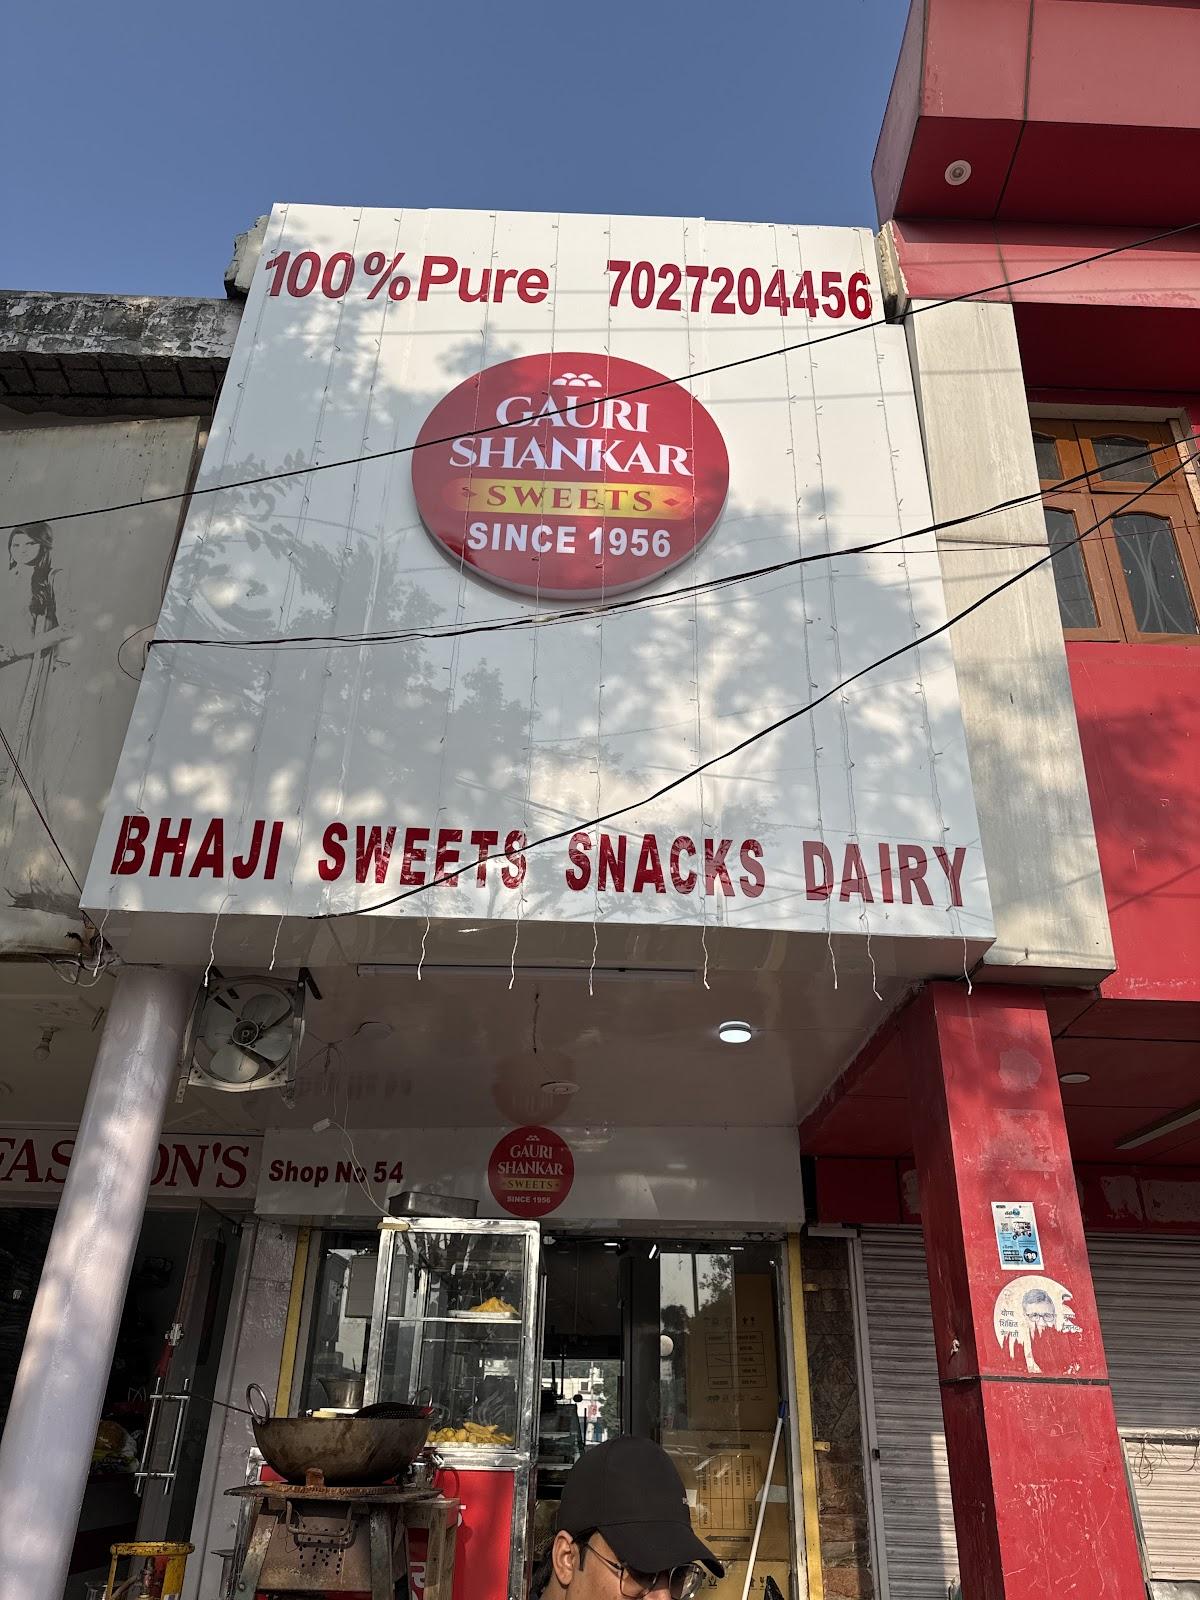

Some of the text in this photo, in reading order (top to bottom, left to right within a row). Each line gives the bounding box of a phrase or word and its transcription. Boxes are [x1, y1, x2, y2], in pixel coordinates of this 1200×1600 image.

[607, 260, 872, 320] 7027204456
[496, 396, 649, 433] GAURI
[449, 436, 694, 476] SHANKAR
[486, 485, 653, 512] SWEETS
[467, 522, 671, 558] SINCE 1956
[110, 815, 967, 907] BHAJI SWEETS SNACKS DAIRY
[509, 1144, 553, 1160] GAURI
[268, 1159, 403, 1188] Shop No 54
[496, 1161, 565, 1176] SHANKAR
[507, 1180, 553, 1190] SWEETS
[507, 1195, 531, 1203] SINCE
